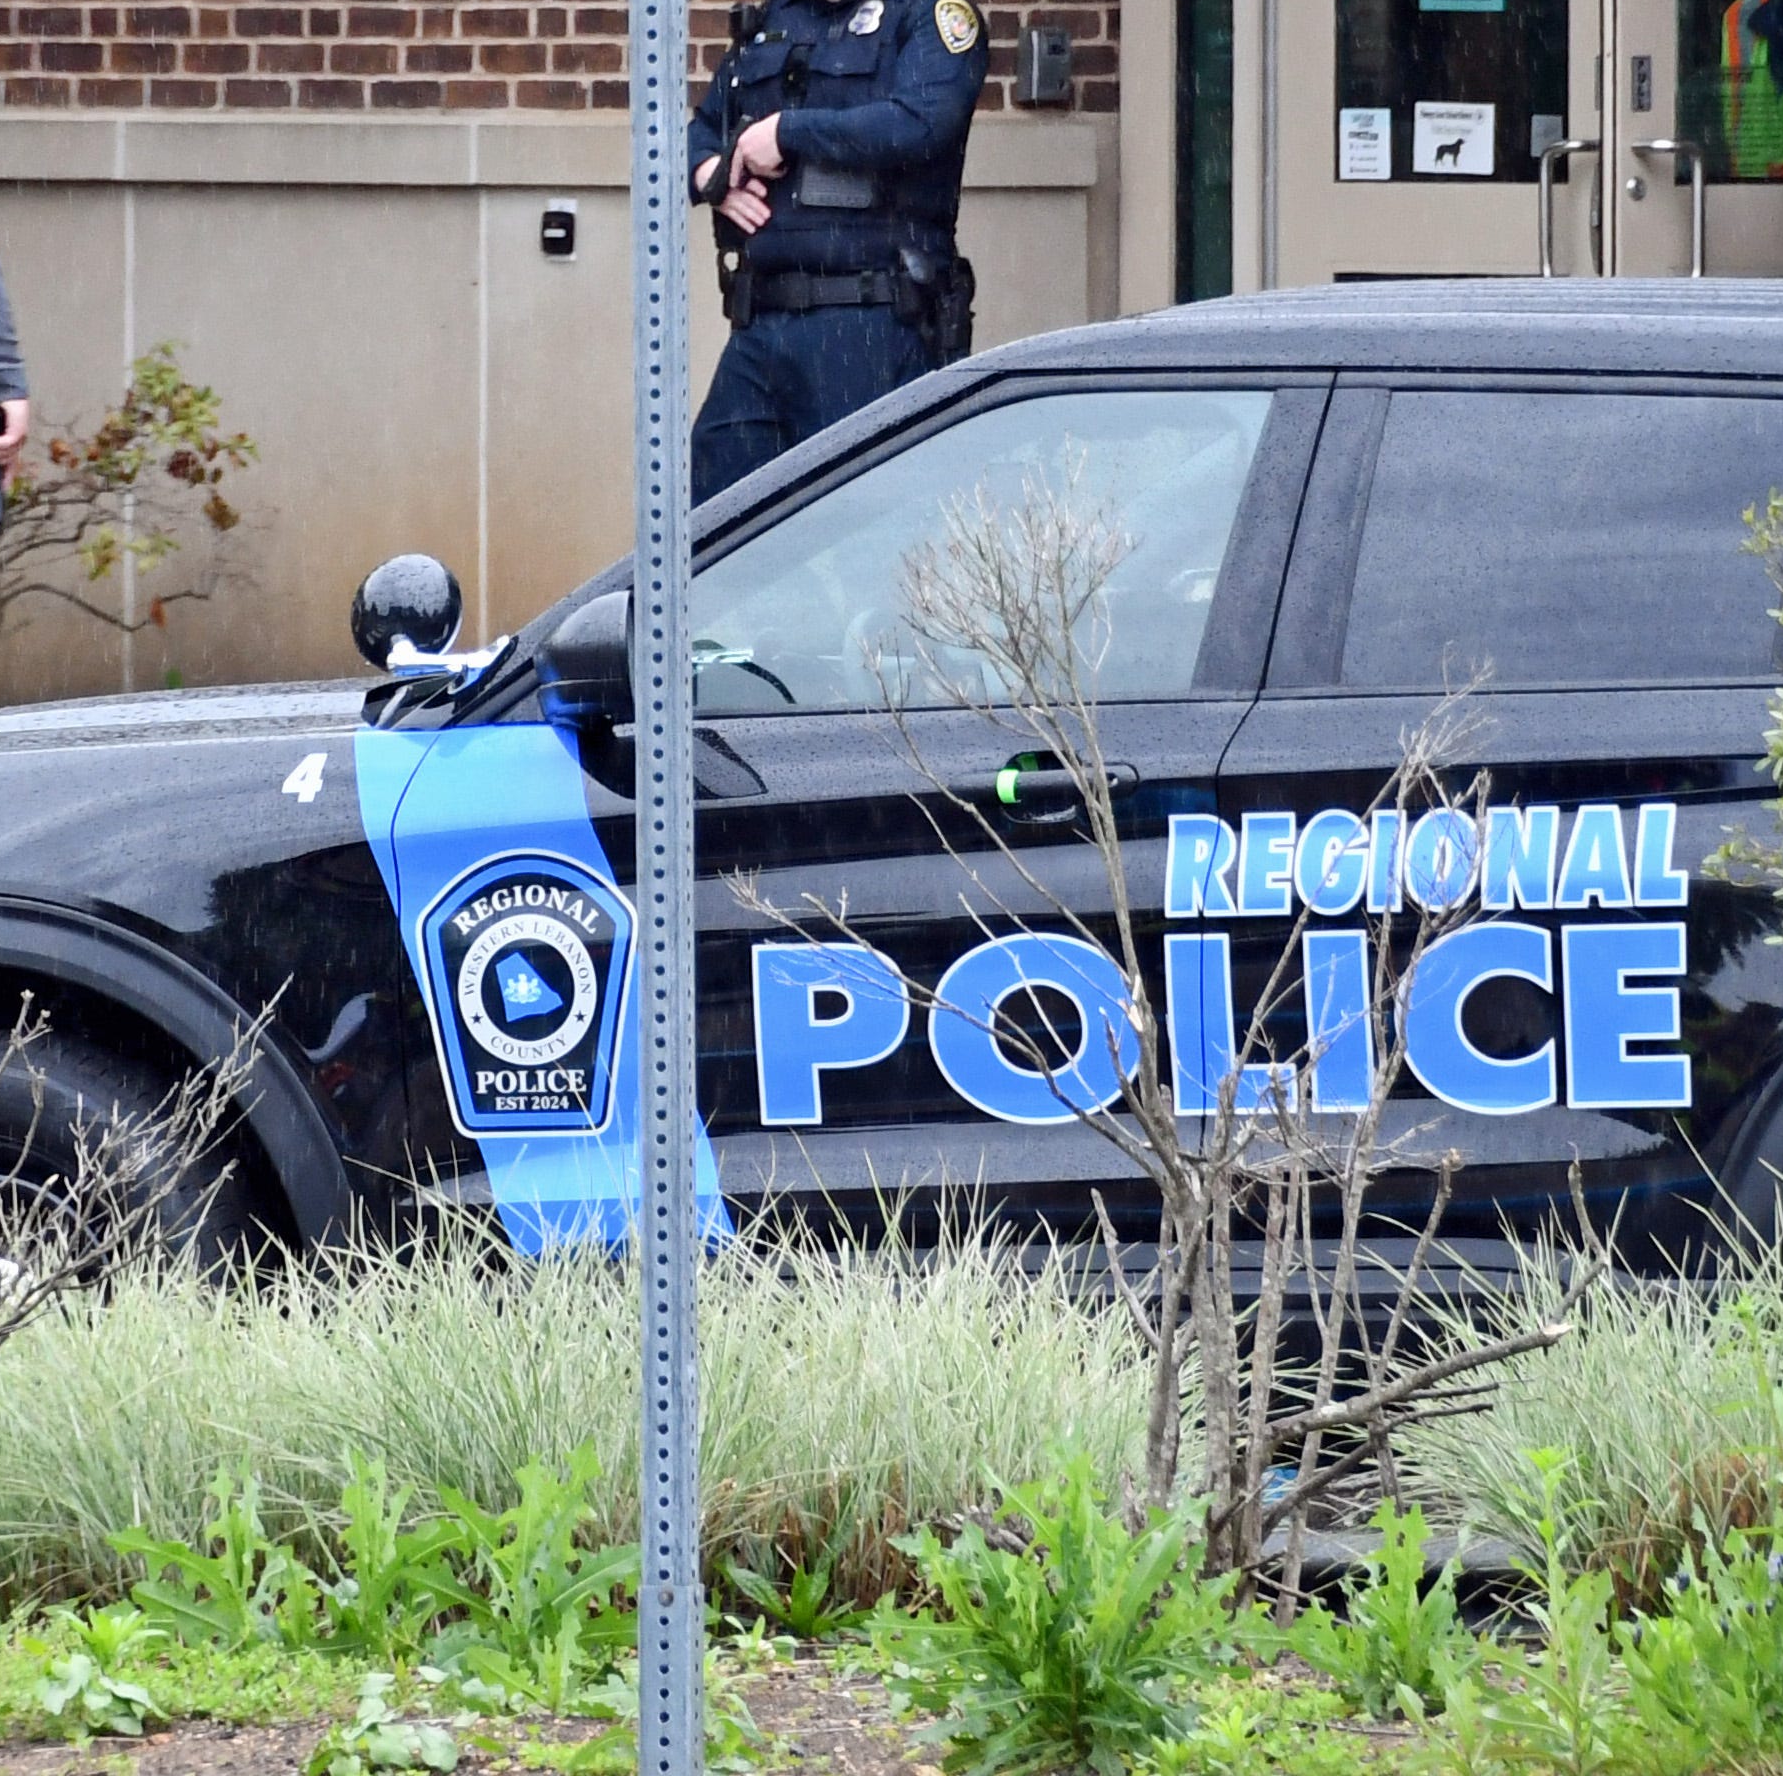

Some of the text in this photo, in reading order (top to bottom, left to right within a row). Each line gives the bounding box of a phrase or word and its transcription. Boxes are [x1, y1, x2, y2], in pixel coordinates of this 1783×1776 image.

[282, 753, 328, 802] 4
[1165, 802, 1689, 918] REGIONAL
[452, 884, 599, 936] REGIONAL
[464, 921, 592, 995] WESTERN LEBANON
[490, 1034, 566, 1060] COUNTY
[751, 920, 1692, 1126] POLICE
[475, 1069, 587, 1095] POLICE
[495, 1095, 570, 1111] EST 2024
